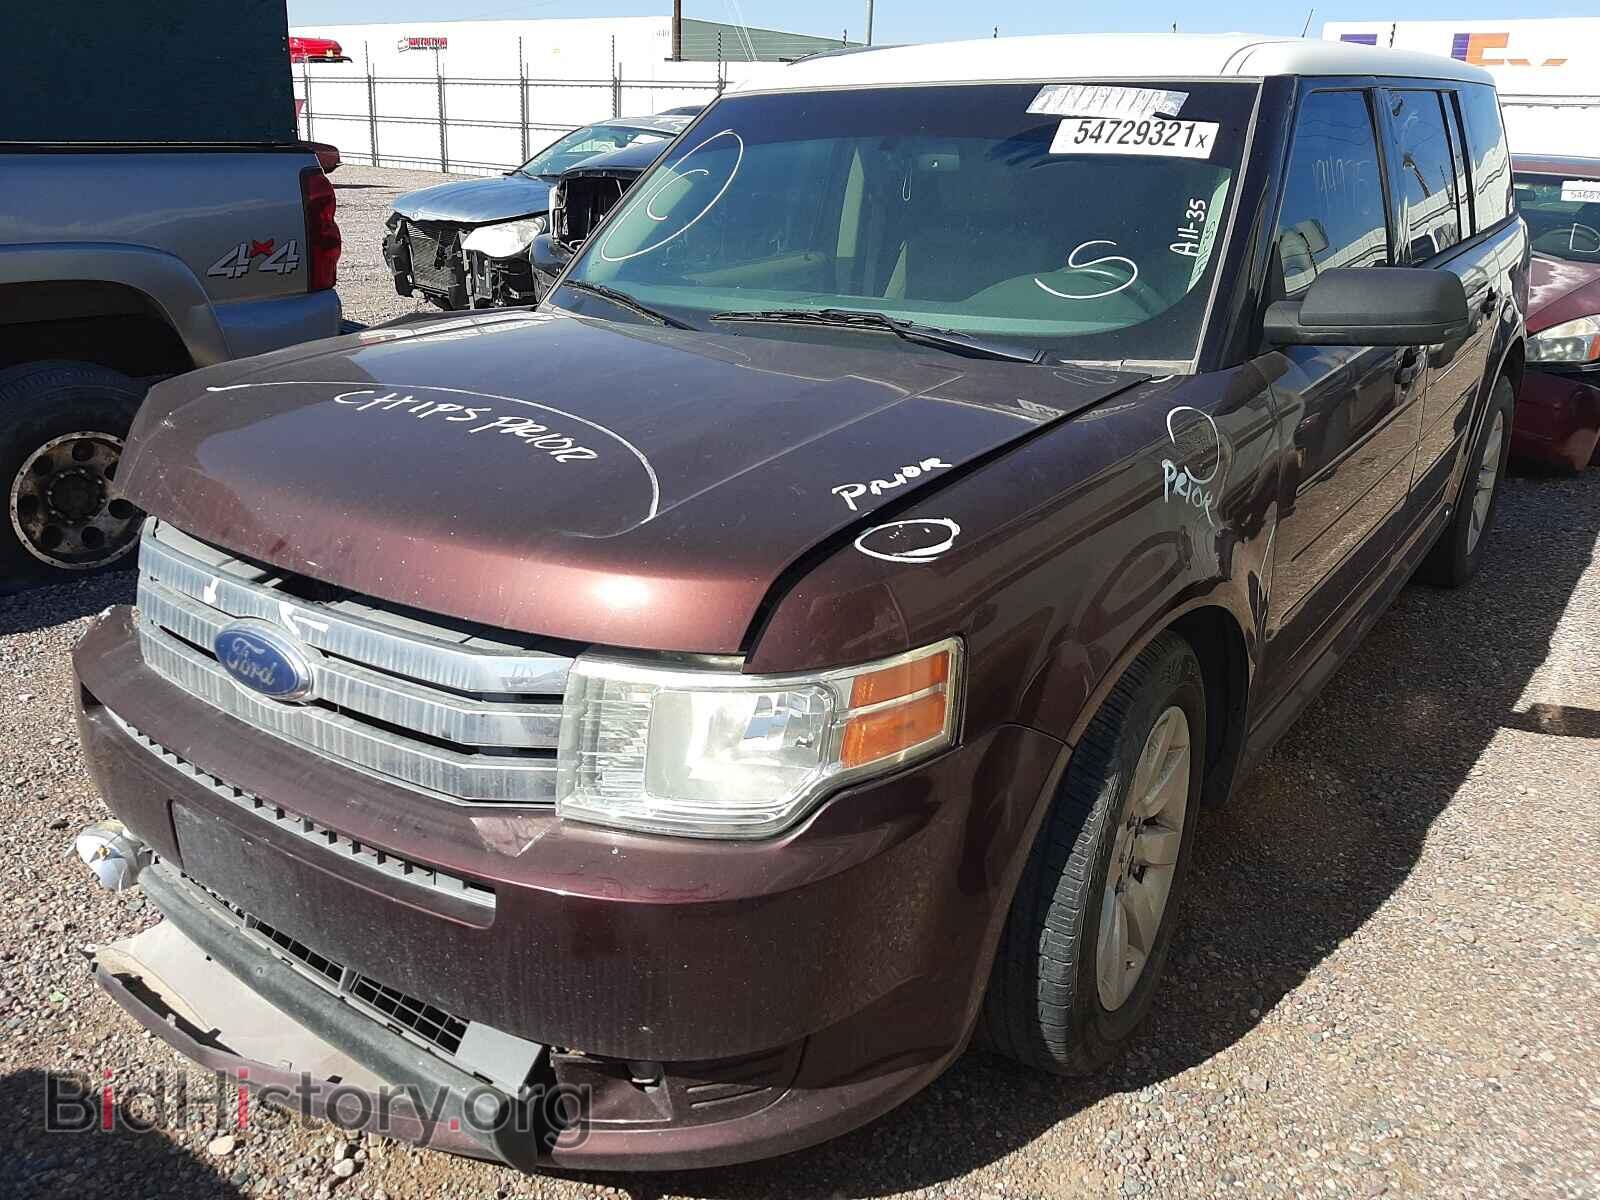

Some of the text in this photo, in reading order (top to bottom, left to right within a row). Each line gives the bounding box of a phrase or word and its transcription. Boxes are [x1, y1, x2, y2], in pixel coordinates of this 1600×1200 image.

[334, 390, 599, 464] CHIPS PRIOR
[831, 455, 953, 511] PRIOR
[1160, 458, 1217, 527] PRIOR
[225, 637, 278, 686] Ford
